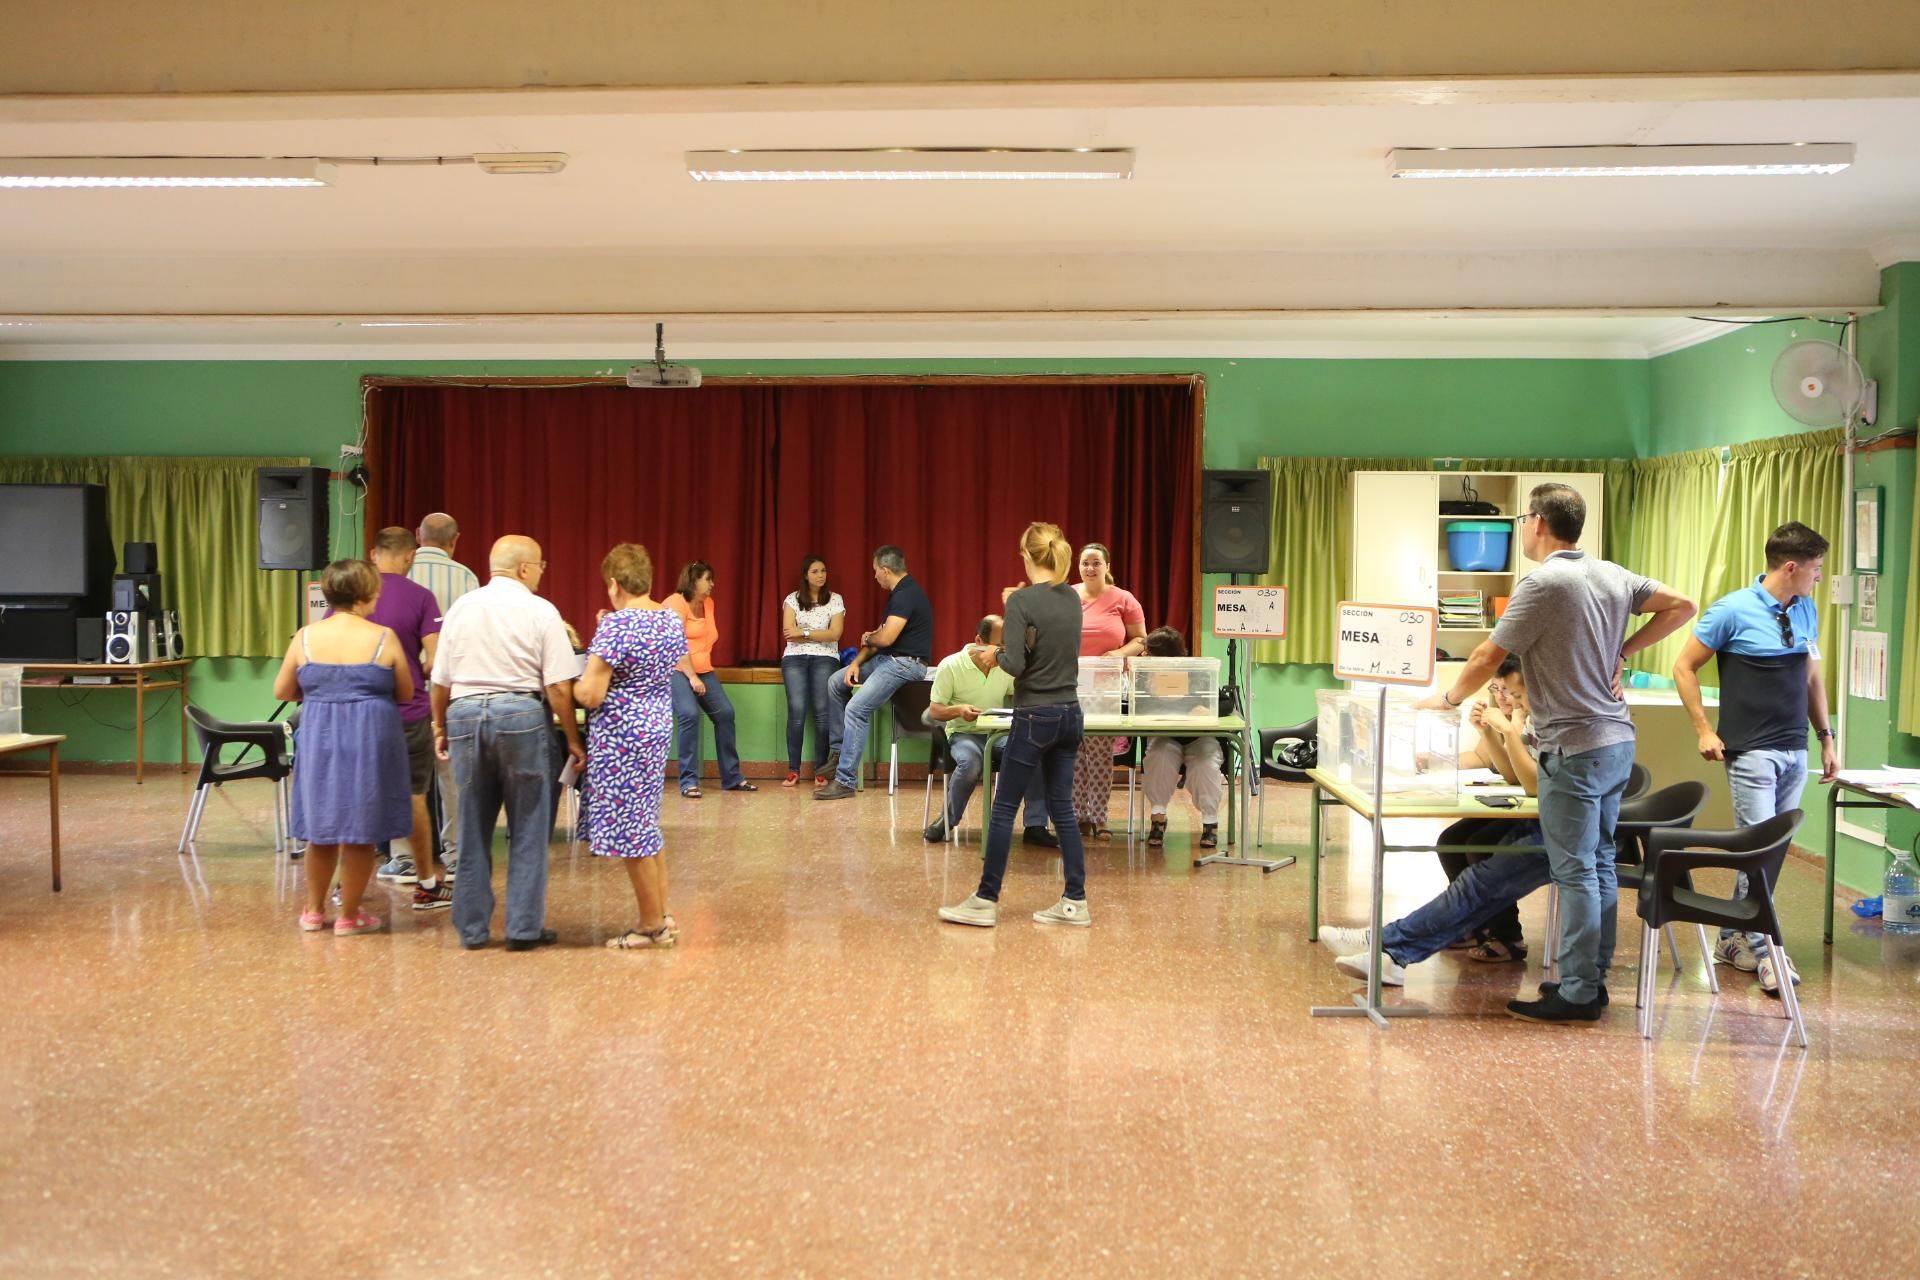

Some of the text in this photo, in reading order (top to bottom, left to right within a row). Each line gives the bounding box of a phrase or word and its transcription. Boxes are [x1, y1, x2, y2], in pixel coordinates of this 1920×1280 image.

[1257, 589, 1278, 597] 030
[1217, 601, 1275, 612] MESA A
[1342, 609, 1424, 624] SECCIÓN 030
[1240, 622, 1246, 631] A
[1341, 630, 1414, 647] MESA B
[1369, 661, 1380, 673] M
